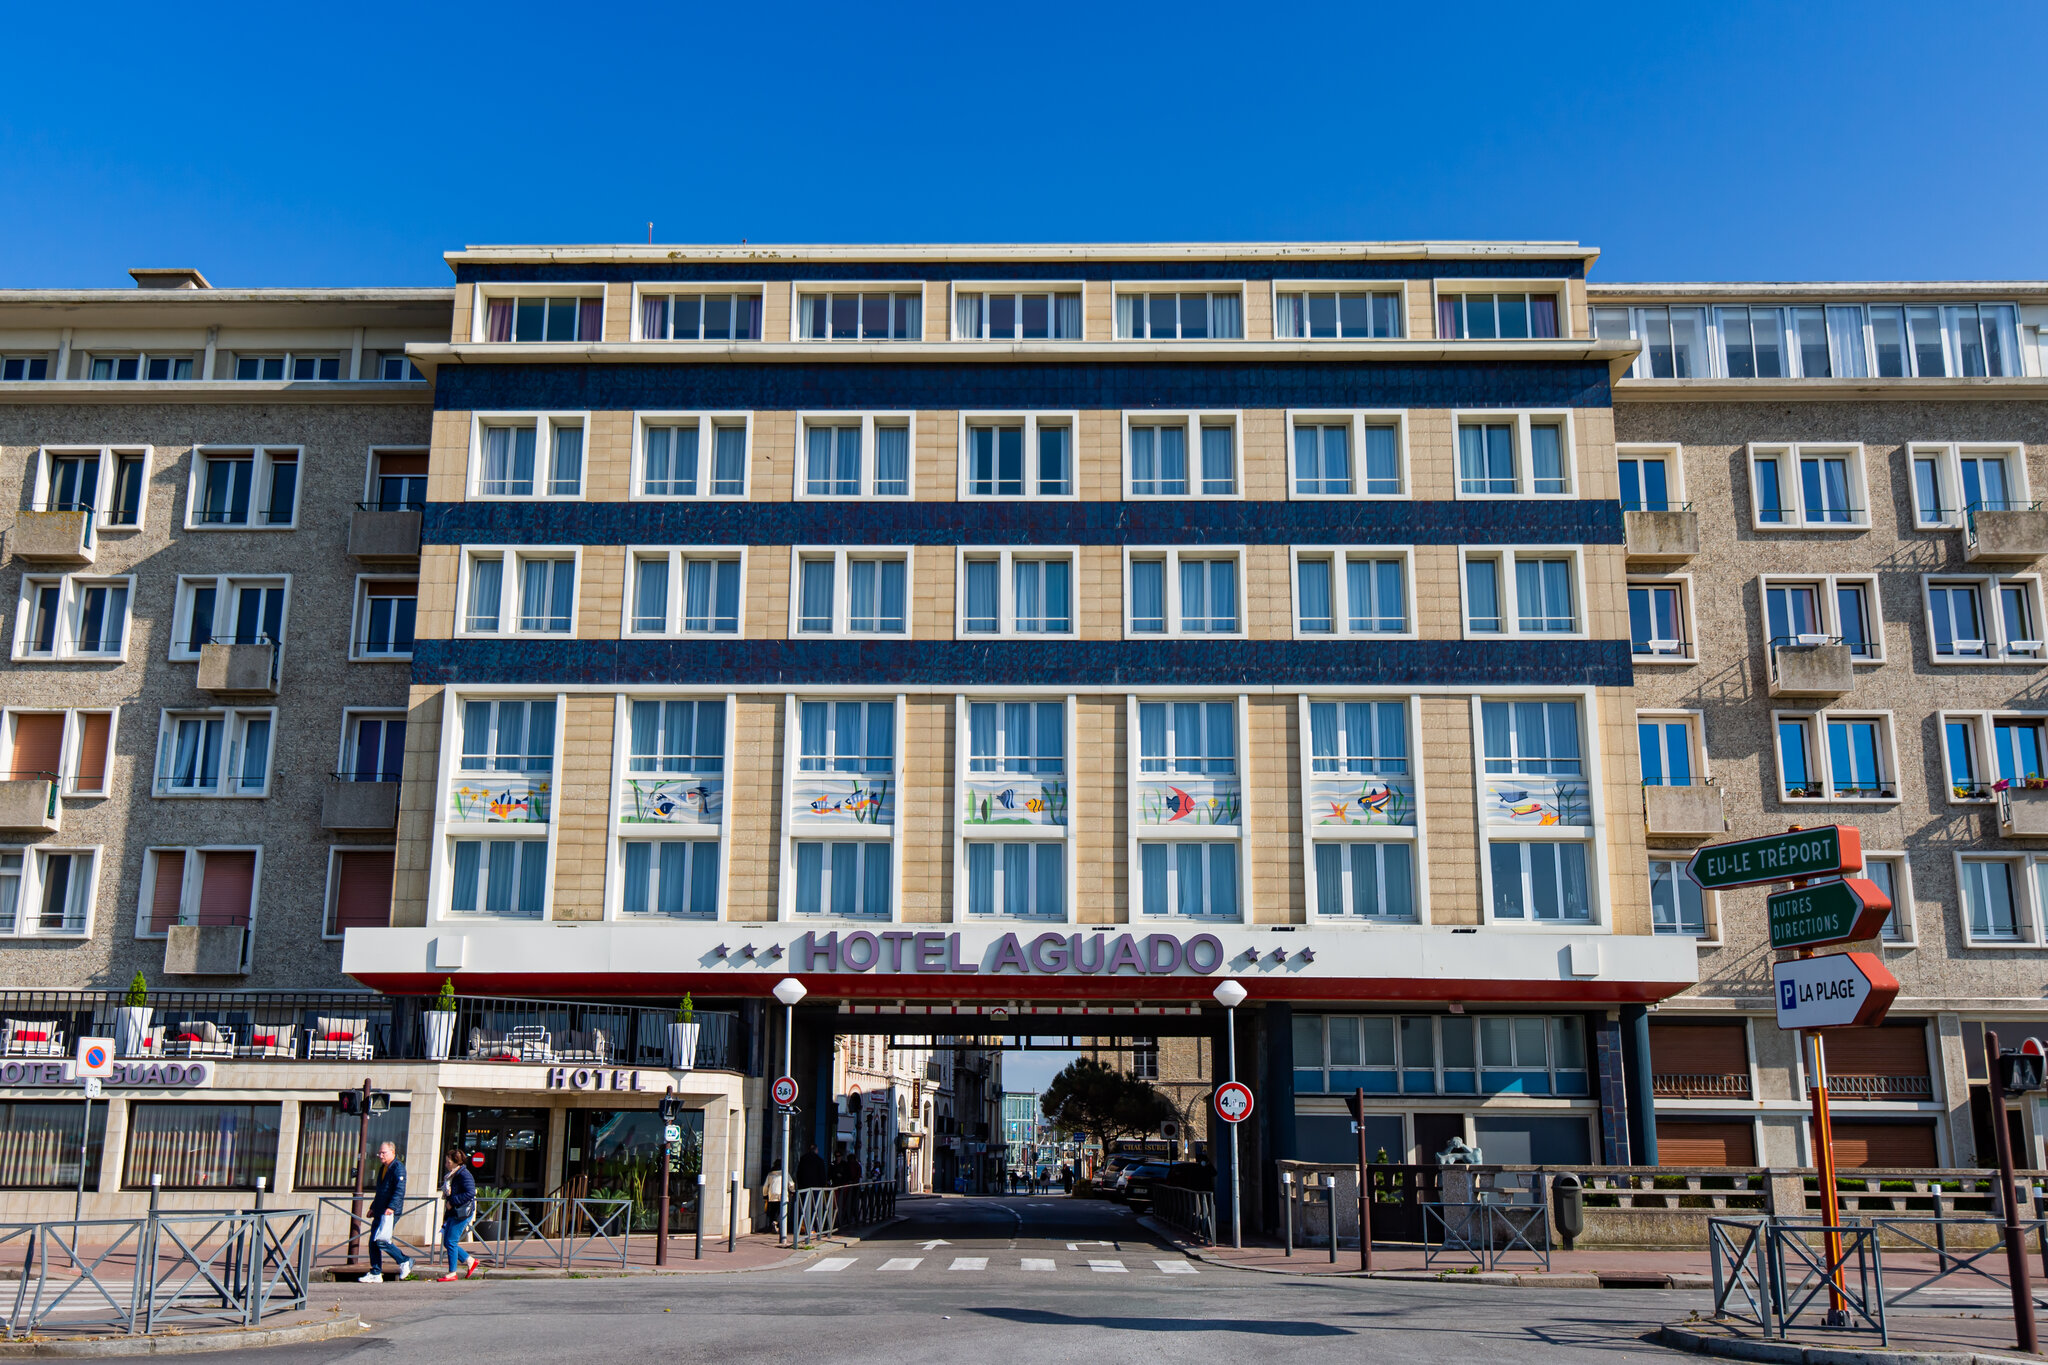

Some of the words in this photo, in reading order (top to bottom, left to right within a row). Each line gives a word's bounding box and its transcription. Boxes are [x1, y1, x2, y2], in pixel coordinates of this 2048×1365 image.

[1707, 852, 1751, 877] EU-LE
[1758, 839, 1831, 869] TRÉPORT
[1773, 897, 1812, 918] AUTRES
[1774, 913, 1839, 940] DIRECTIONS
[806, 930, 980, 972] HOTEL
[992, 932, 1225, 974] AGUADO
[1800, 983, 1814, 1002] LA
[1816, 979, 1855, 1000] PLAGE
[0, 1062, 76, 1084] OTEL
[84, 1063, 206, 1085] GUADO
[551, 1067, 646, 1091] HOTEL
